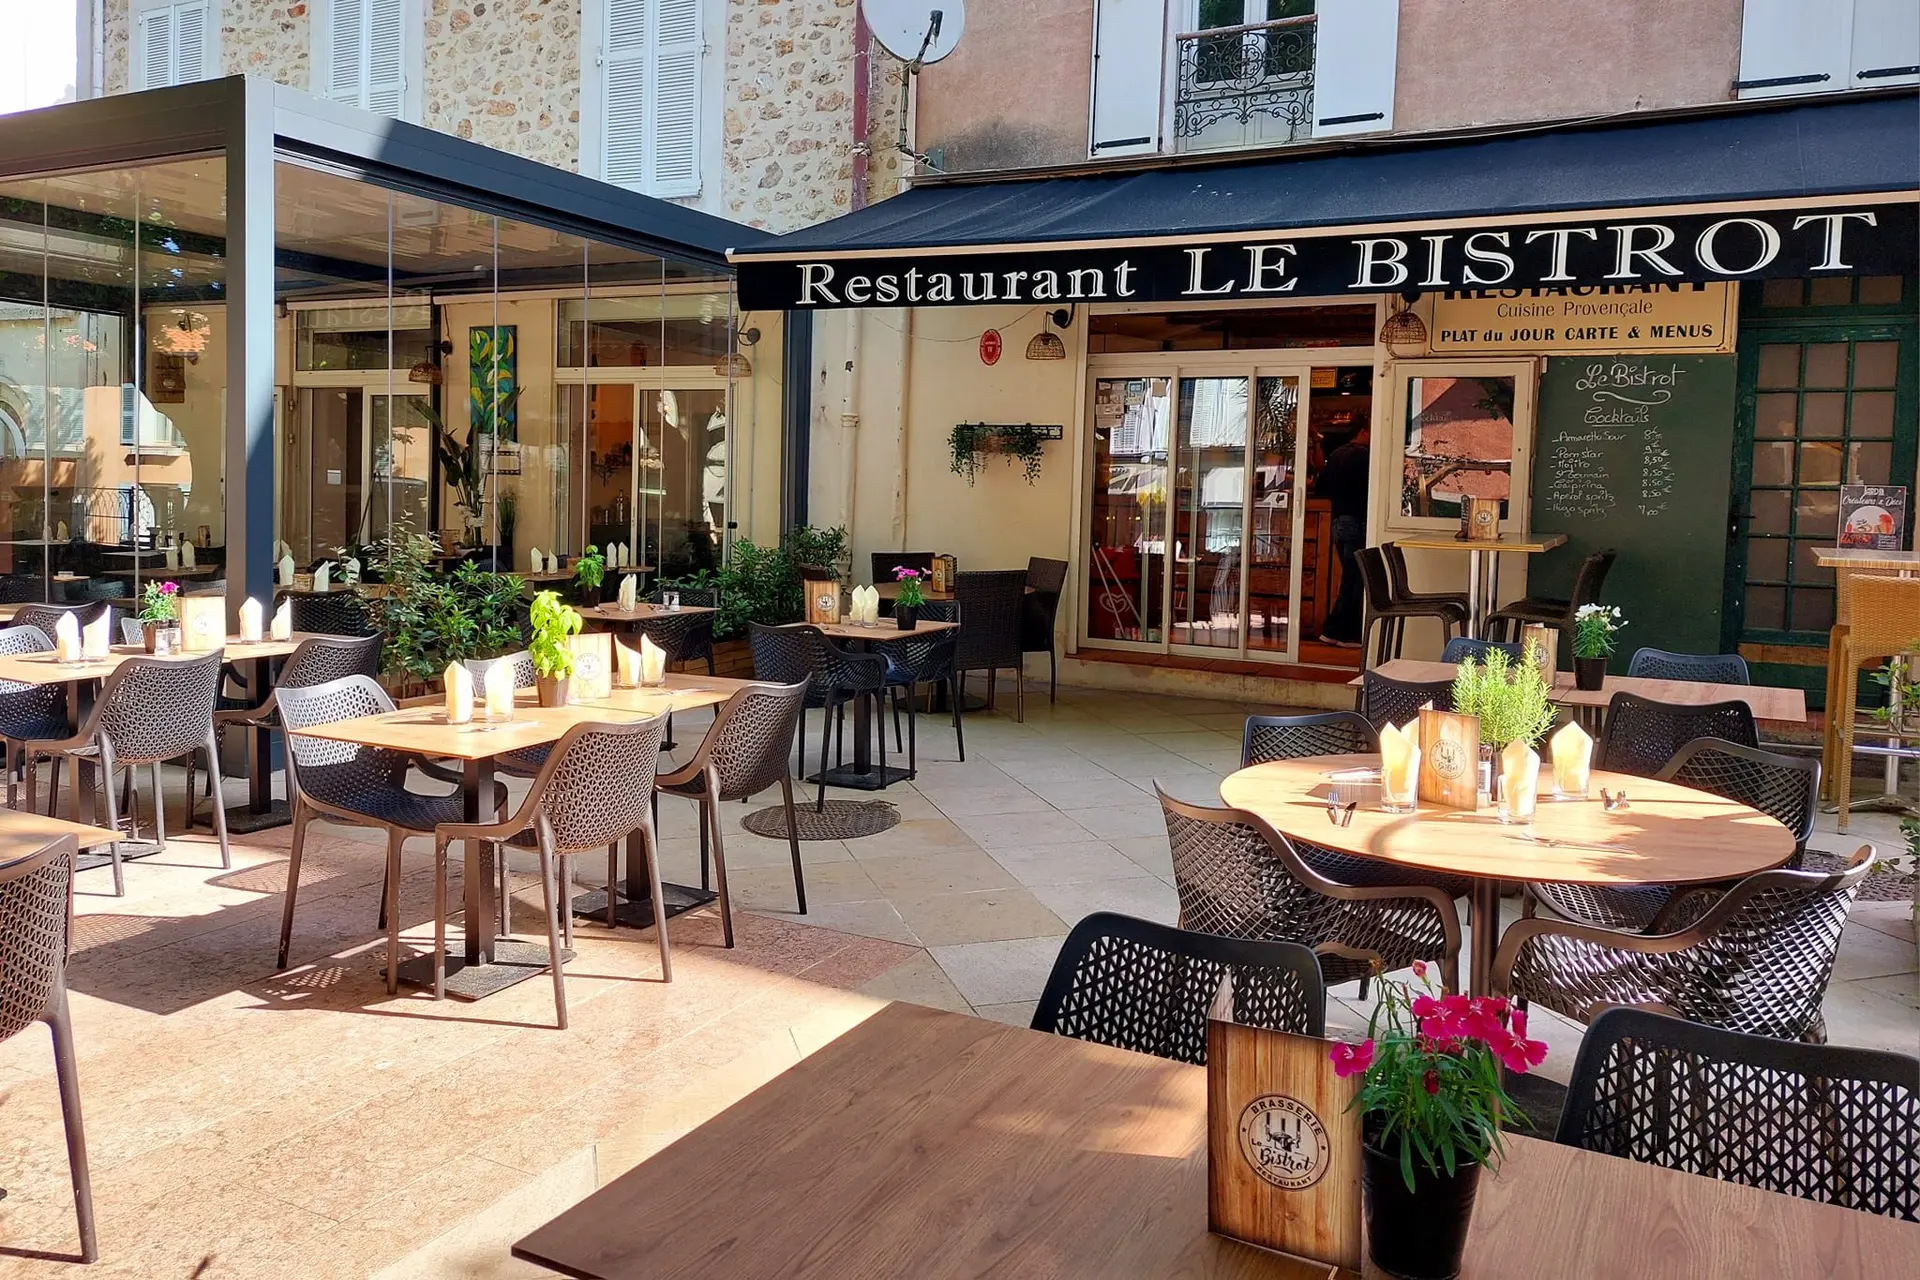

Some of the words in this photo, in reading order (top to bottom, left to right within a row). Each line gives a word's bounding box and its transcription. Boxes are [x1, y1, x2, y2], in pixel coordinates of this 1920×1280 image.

[795, 260, 1137, 304] Restaurant
[1181, 244, 1298, 295] LE
[1348, 212, 1877, 288] BISTROT
[1497, 303, 1555, 318] Cuisine
[1564, 299, 1653, 317] Provençale
[1441, 329, 1477, 342] PLAT
[1483, 328, 1502, 341] du
[1510, 327, 1555, 341] JOUR
[1565, 325, 1618, 340] CARTE
[1627, 326, 1640, 339] &
[1650, 324, 1713, 338] MENUS
[1576, 364, 1610, 390] Le
[1610, 363, 1686, 388] Bistrot
[1584, 405, 1649, 424] Cocktails
[1251, 1099, 1323, 1136] BRASSERIE
[1251, 1138, 1262, 1147] Le
[1261, 1147, 1314, 1171] Bistrot
[1257, 1166, 1312, 1187] RESTAURANT
